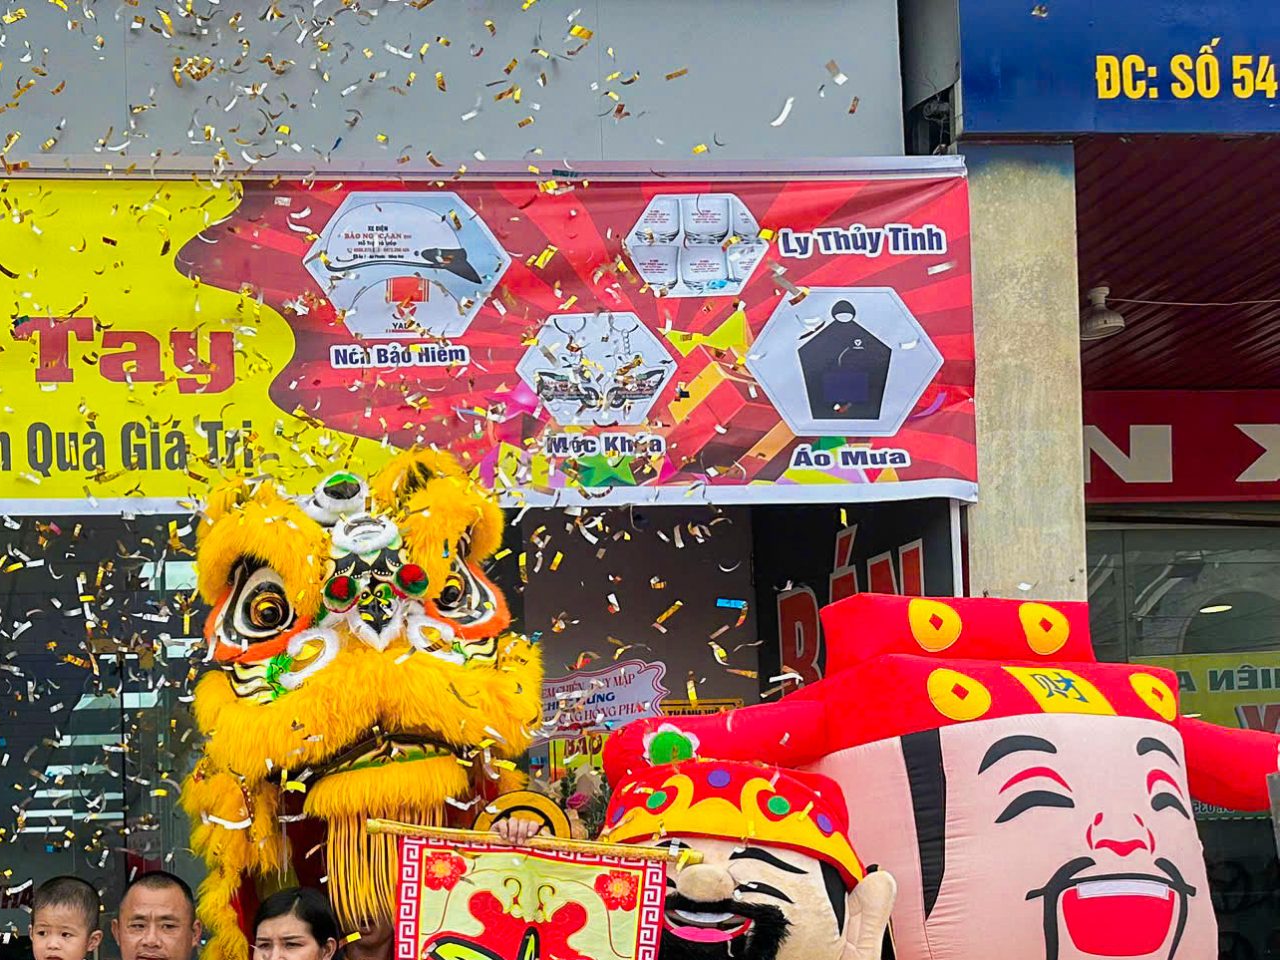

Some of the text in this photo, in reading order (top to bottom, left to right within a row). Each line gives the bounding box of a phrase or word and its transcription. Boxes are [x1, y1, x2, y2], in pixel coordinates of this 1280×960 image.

[1095, 37, 1278, 99] ĐC: SỐ 54
[782, 226, 943, 255] Ly Thủy Tinh
[14, 316, 235, 394] Tay
[376, 345, 412, 364] Bảo
[26, 420, 106, 477] Quà
[121, 419, 188, 472] Giá
[604, 433, 662, 454] Kha
[794, 447, 907, 467] Áo Mưa
